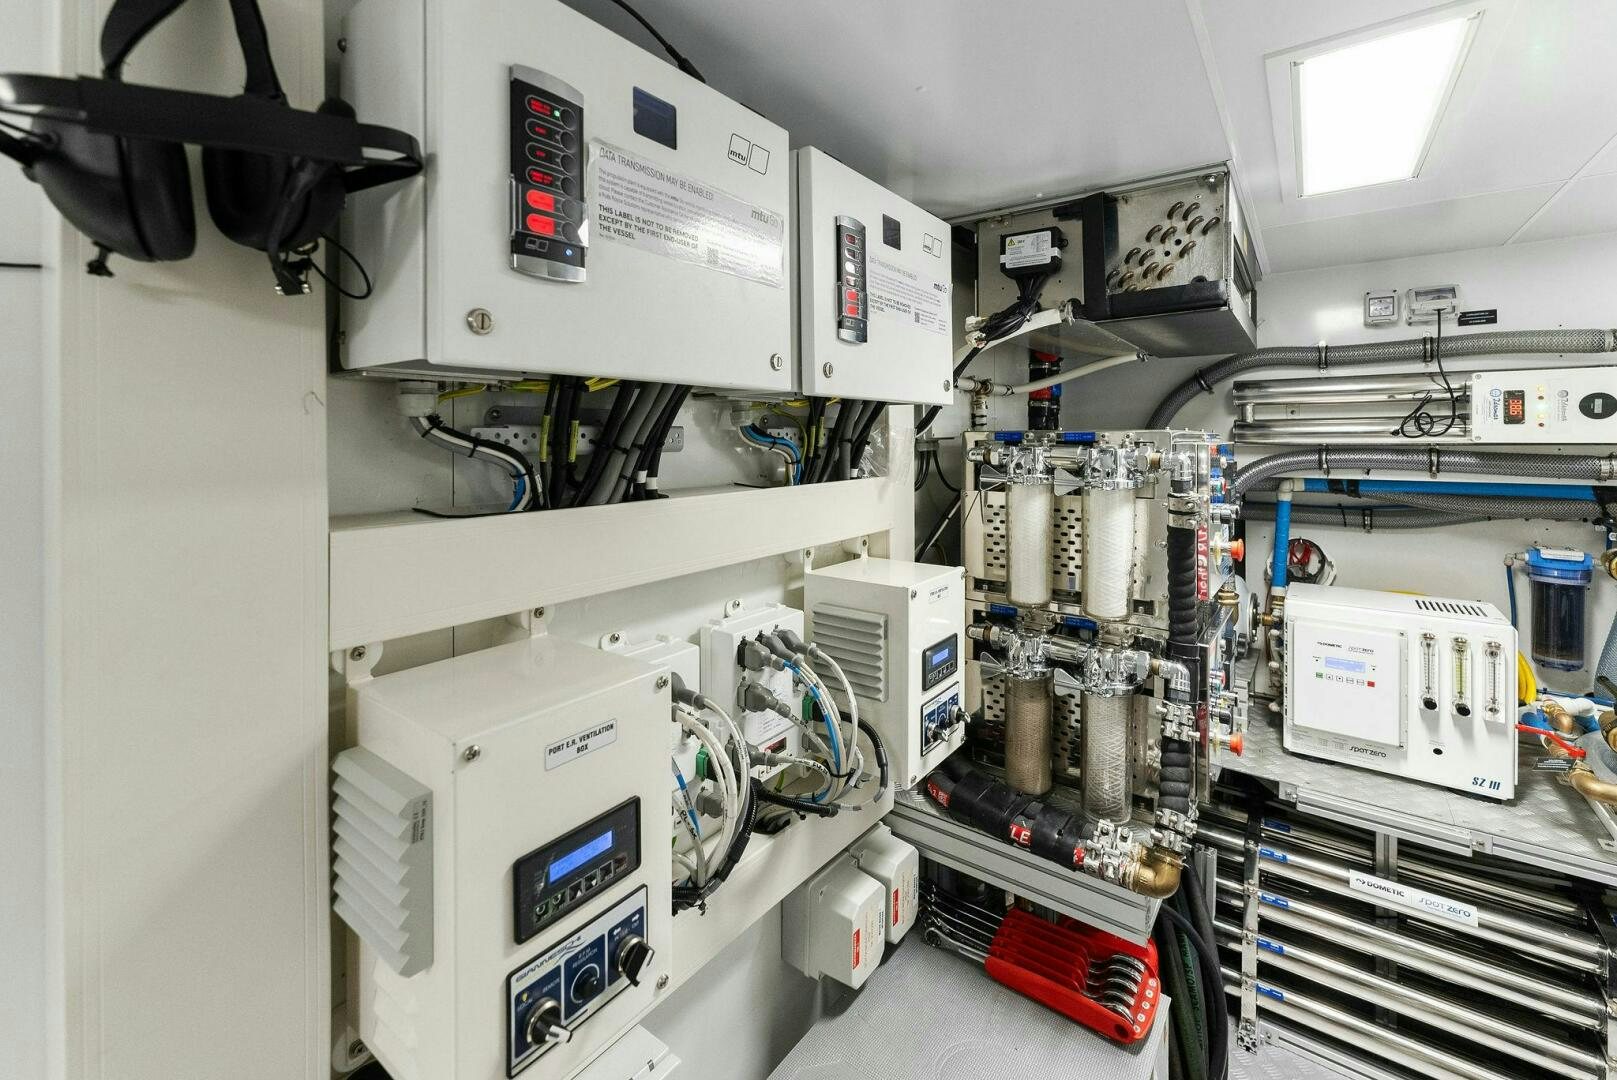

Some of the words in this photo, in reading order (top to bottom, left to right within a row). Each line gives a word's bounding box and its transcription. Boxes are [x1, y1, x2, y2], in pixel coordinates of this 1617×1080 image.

[729, 150, 747, 162] mtu
[600, 147, 616, 163] DATA
[618, 154, 665, 182] TRANSMISSION
[666, 174, 678, 187] MAY
[680, 179, 687, 191] BE
[688, 184, 713, 201] ENABLED
[599, 203, 613, 215] THIS
[614, 208, 634, 221] LABEL
[635, 215, 641, 223] IS
[642, 217, 655, 228] NOT
[656, 221, 664, 231] TO
[665, 225, 672, 234] BE
[673, 227, 699, 242] REMOVED
[751, 209, 768, 225] mtu
[599, 213, 623, 228] EXCEPT
[624, 220, 633, 230] BY
[634, 224, 646, 234] THE
[646, 228, 662, 240] FIRST
[663, 233, 690, 249] END-USER
[691, 240, 698, 249] OF
[599, 222, 612, 233] THE
[613, 227, 636, 240] VESSEL
[548, 743, 564, 756] PORT
[579, 723, 614, 743] VENTILATION
[576, 743, 588, 754] BOX
[1472, 776, 1486, 787] SZ
[1367, 880, 1405, 897] DOMETIC
